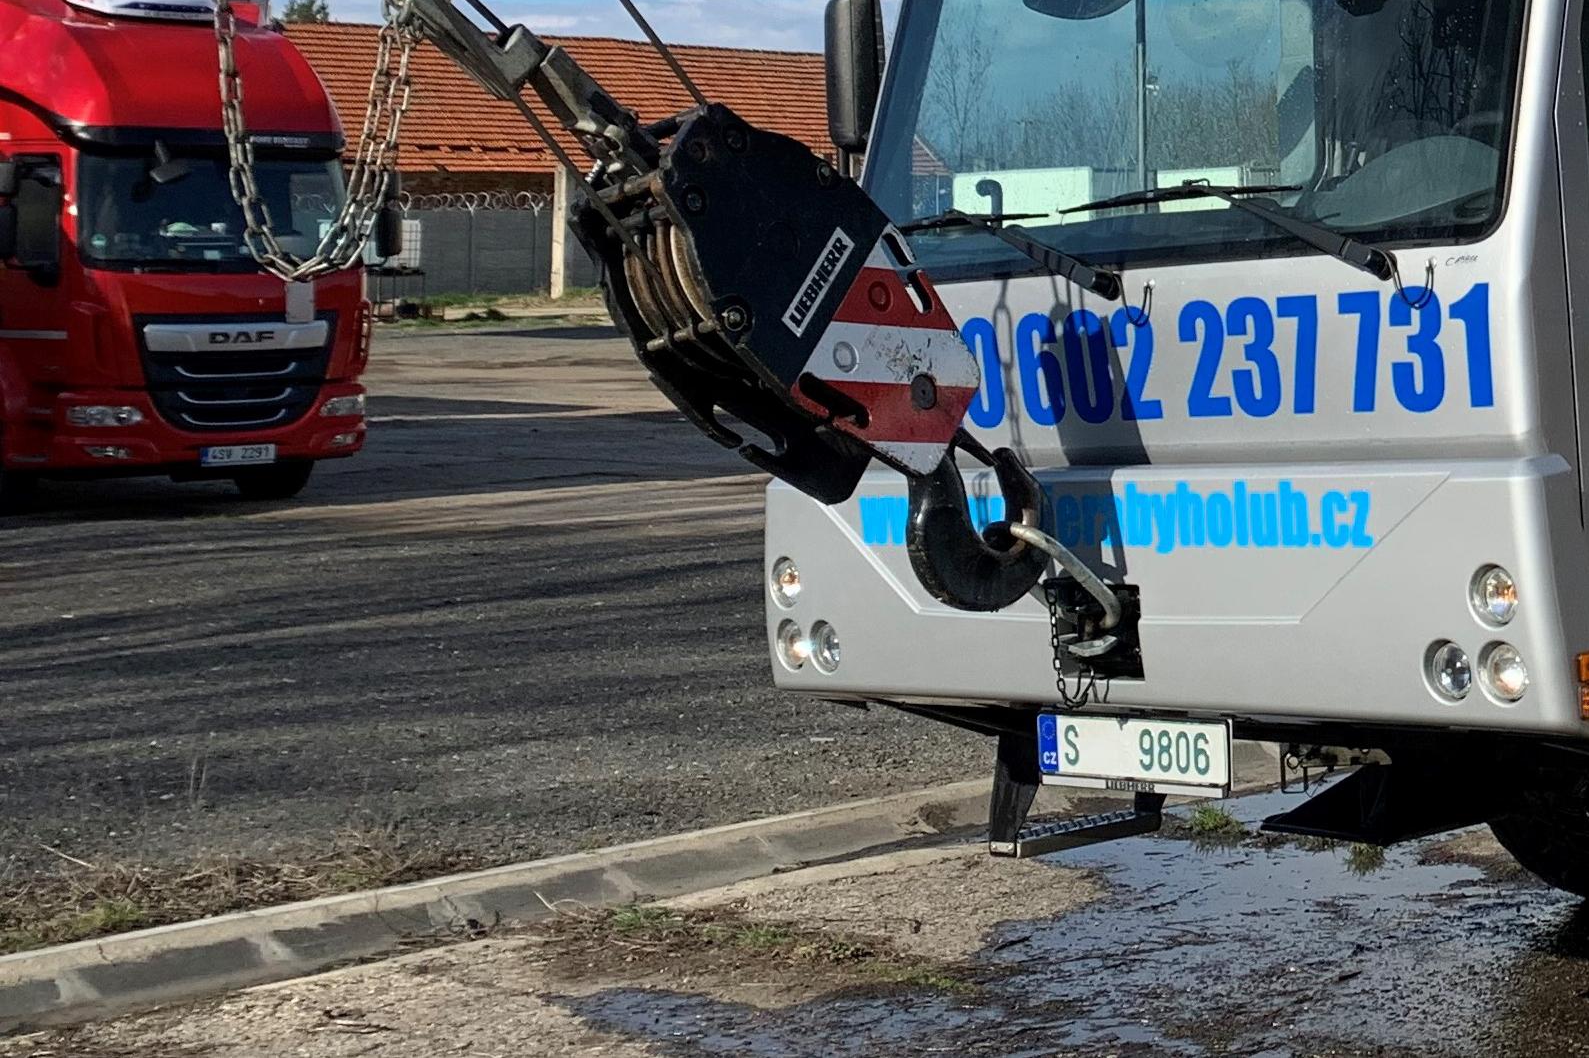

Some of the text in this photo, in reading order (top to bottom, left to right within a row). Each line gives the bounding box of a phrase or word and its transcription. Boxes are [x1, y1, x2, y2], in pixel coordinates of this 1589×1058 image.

[788, 235, 850, 329] LIEBHERR
[209, 330, 275, 344] DAF
[1015, 305, 1164, 427] 602
[1177, 294, 1319, 419] 237
[1336, 282, 1495, 414] 731
[1043, 750, 1058, 765] CZ
[1064, 724, 1210, 776] S 9806
